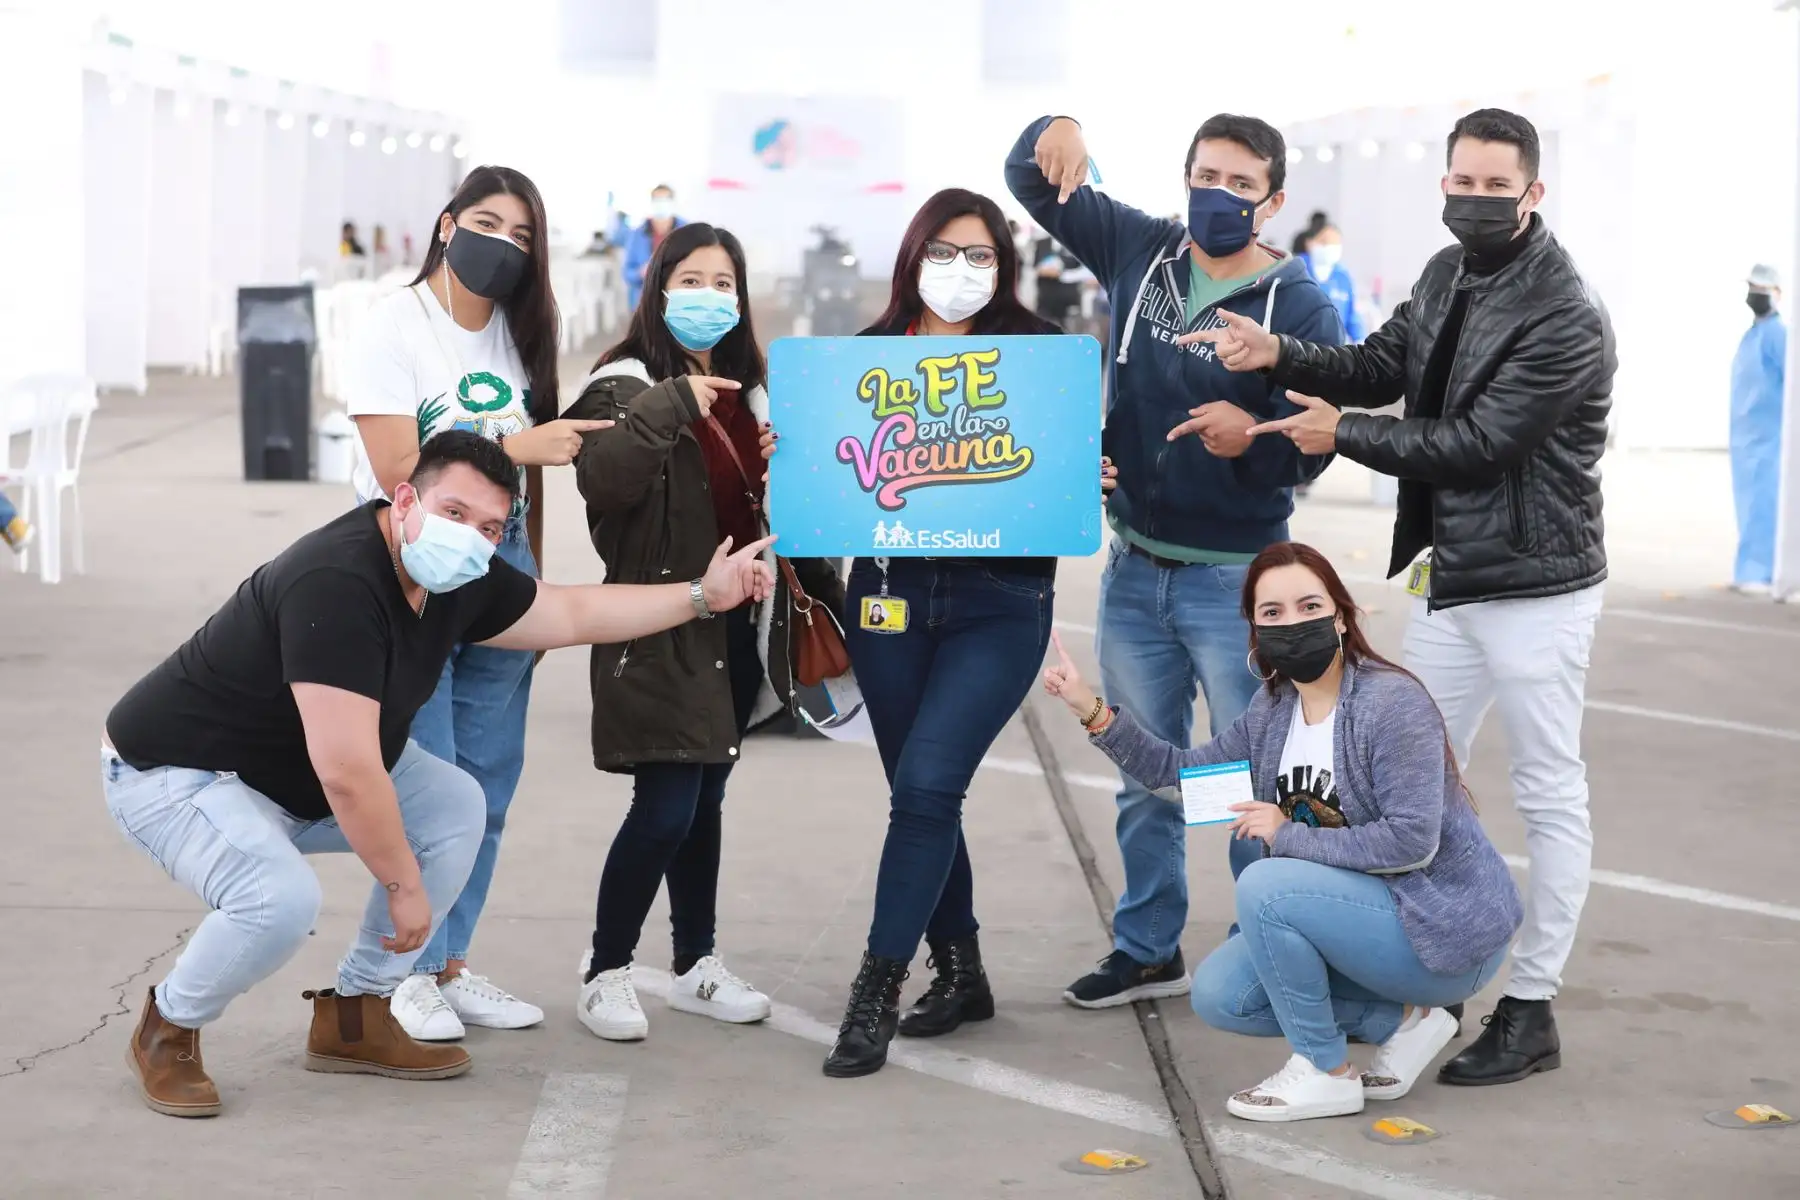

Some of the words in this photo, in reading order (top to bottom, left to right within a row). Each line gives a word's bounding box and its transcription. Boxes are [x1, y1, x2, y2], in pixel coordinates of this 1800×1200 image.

[1187, 341, 1216, 363] ORK
[857, 367, 920, 418] La
[916, 348, 1007, 416] FE
[917, 421, 951, 442] en
[951, 405, 1007, 437] la
[836, 414, 1035, 511] Vacuna
[917, 528, 1000, 549] EsSalud
